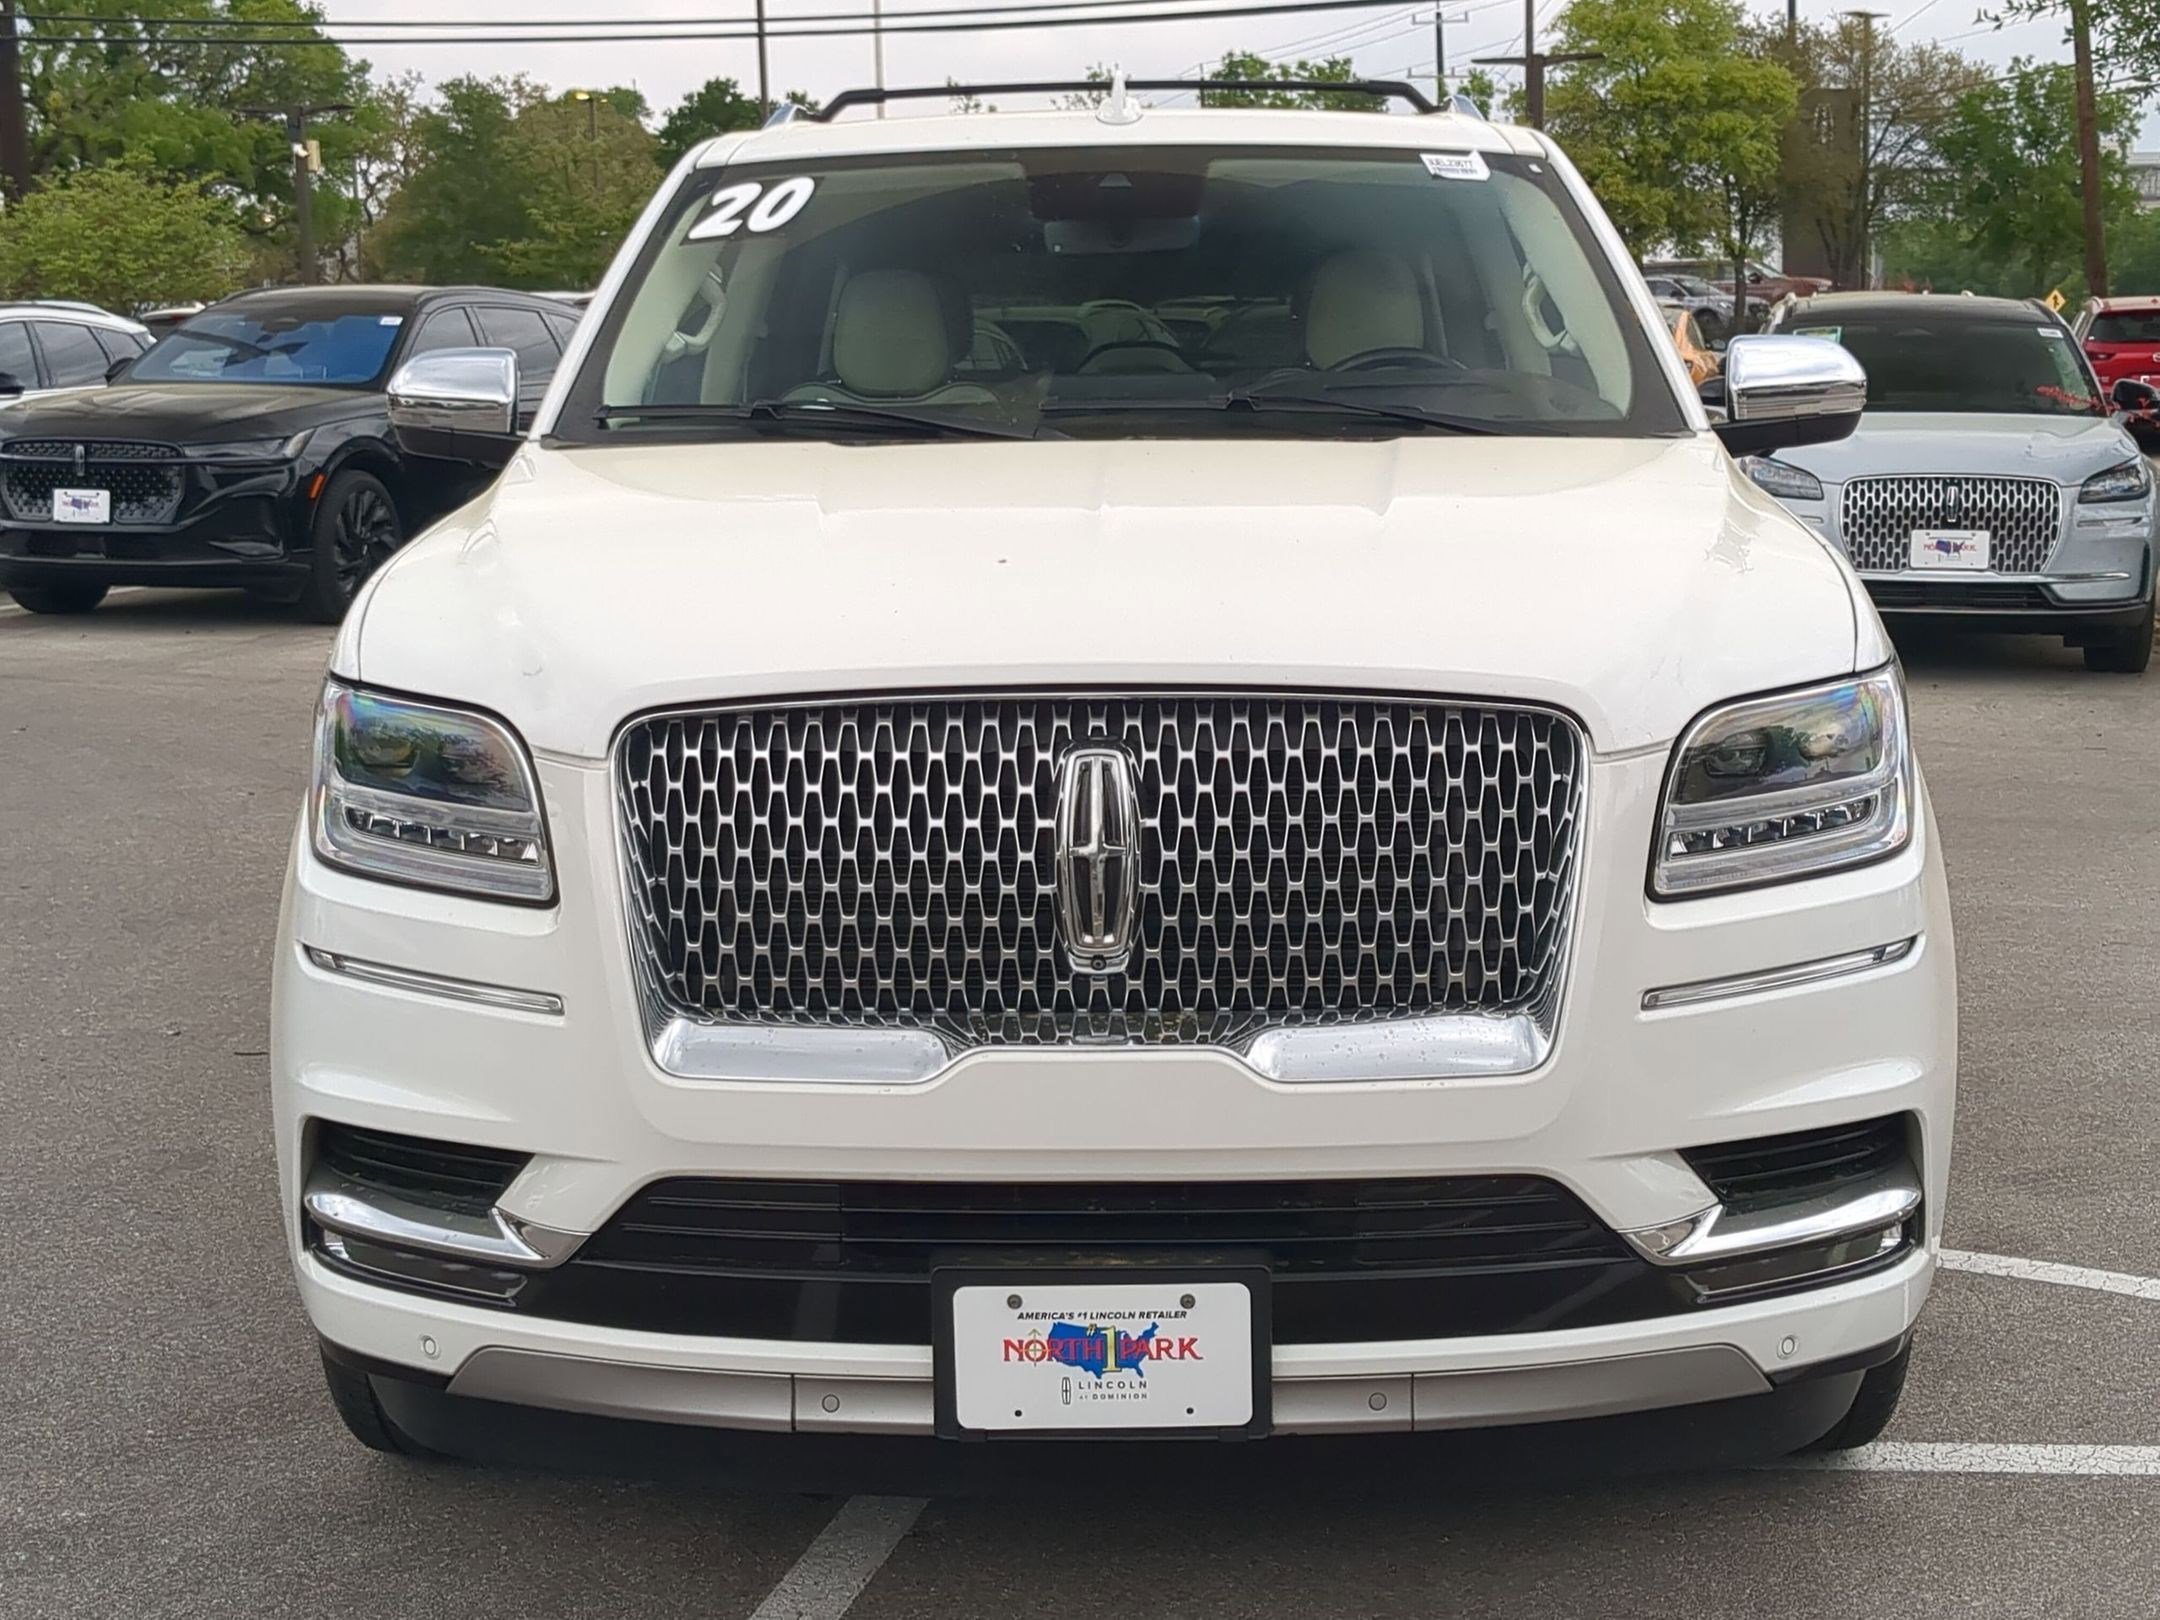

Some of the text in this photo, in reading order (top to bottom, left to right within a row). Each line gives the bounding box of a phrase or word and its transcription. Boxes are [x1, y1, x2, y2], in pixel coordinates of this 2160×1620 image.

[688, 177, 815, 240] 20
[1017, 1310, 1187, 1320] AMERICA'S #1 LINCOLN RETAILER
[1003, 1336, 1204, 1362] NORTH PARK
[1078, 1380, 1147, 1390] LINCOLN
[1092, 1392, 1147, 1401] DOMINION
